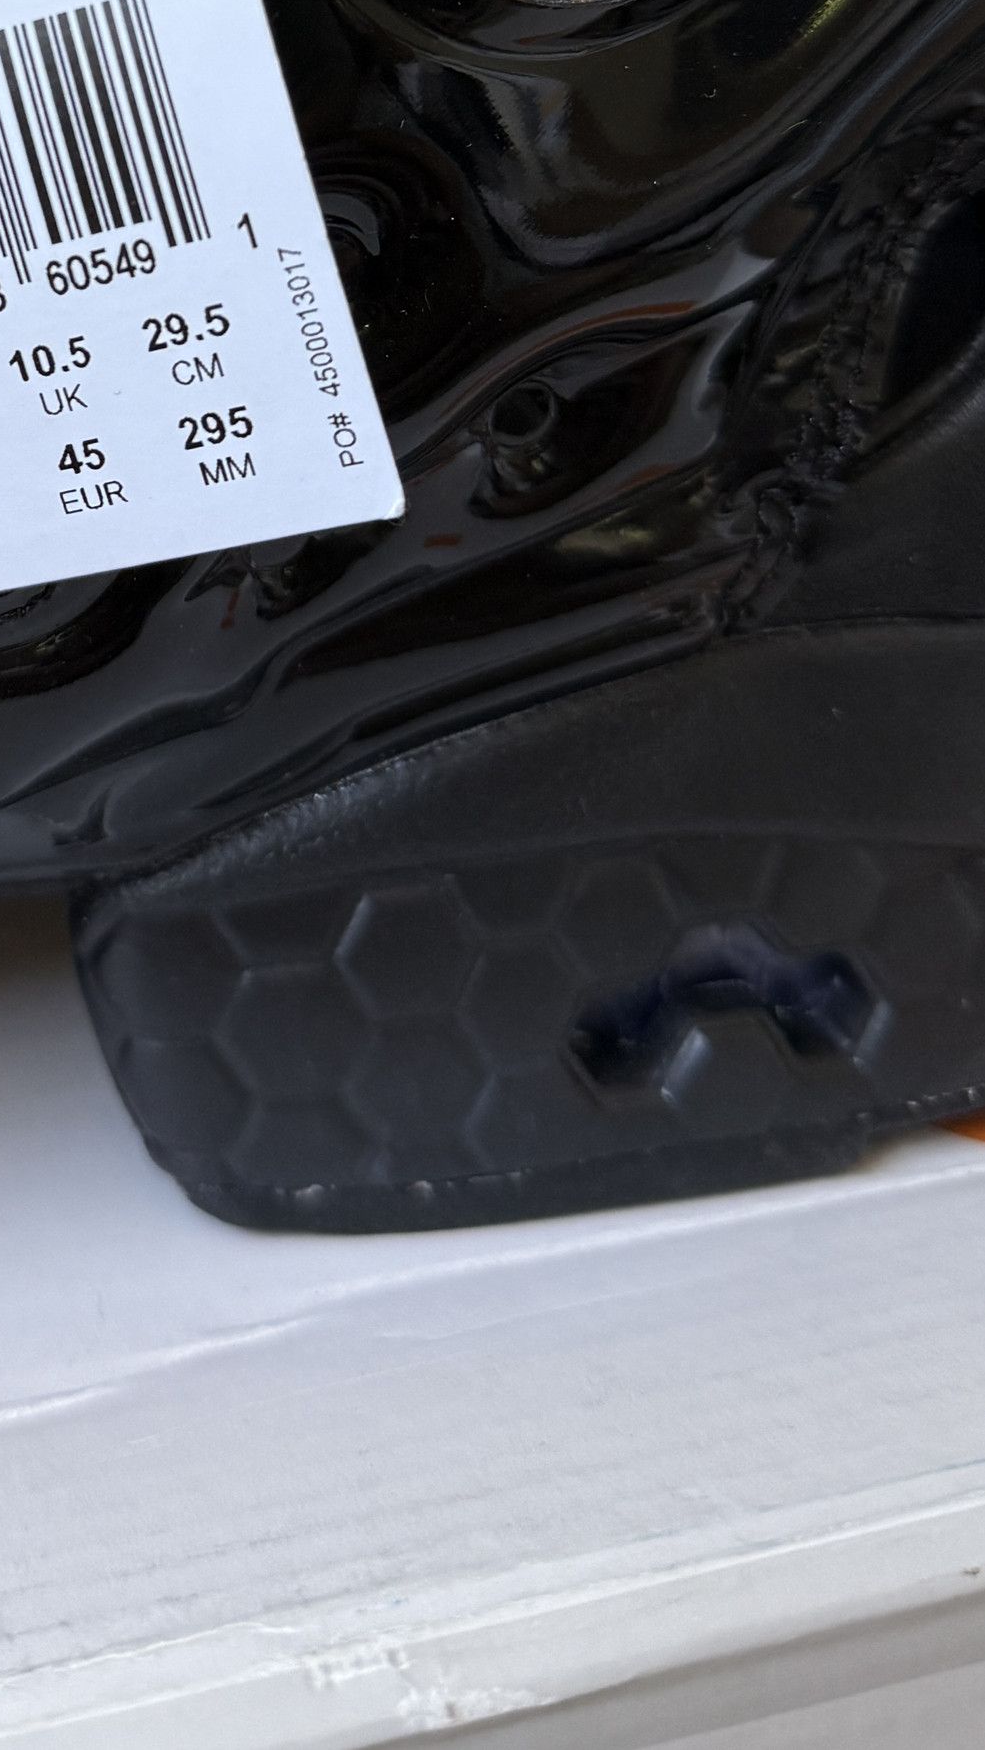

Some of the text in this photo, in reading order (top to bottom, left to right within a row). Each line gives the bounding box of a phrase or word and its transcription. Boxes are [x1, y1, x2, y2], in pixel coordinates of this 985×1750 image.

[45, 238, 157, 296] 60549
[237, 212, 258, 249] 1
[141, 302, 230, 353] 29.5
[8, 335, 92, 382] 10.5
[171, 352, 225, 386] CM
[276, 247, 365, 468] PO# 4500013017
[38, 383, 89, 416] UK
[178, 405, 254, 451] 295
[58, 437, 106, 475] 45
[198, 452, 257, 486] MM
[59, 480, 129, 515] EUR
